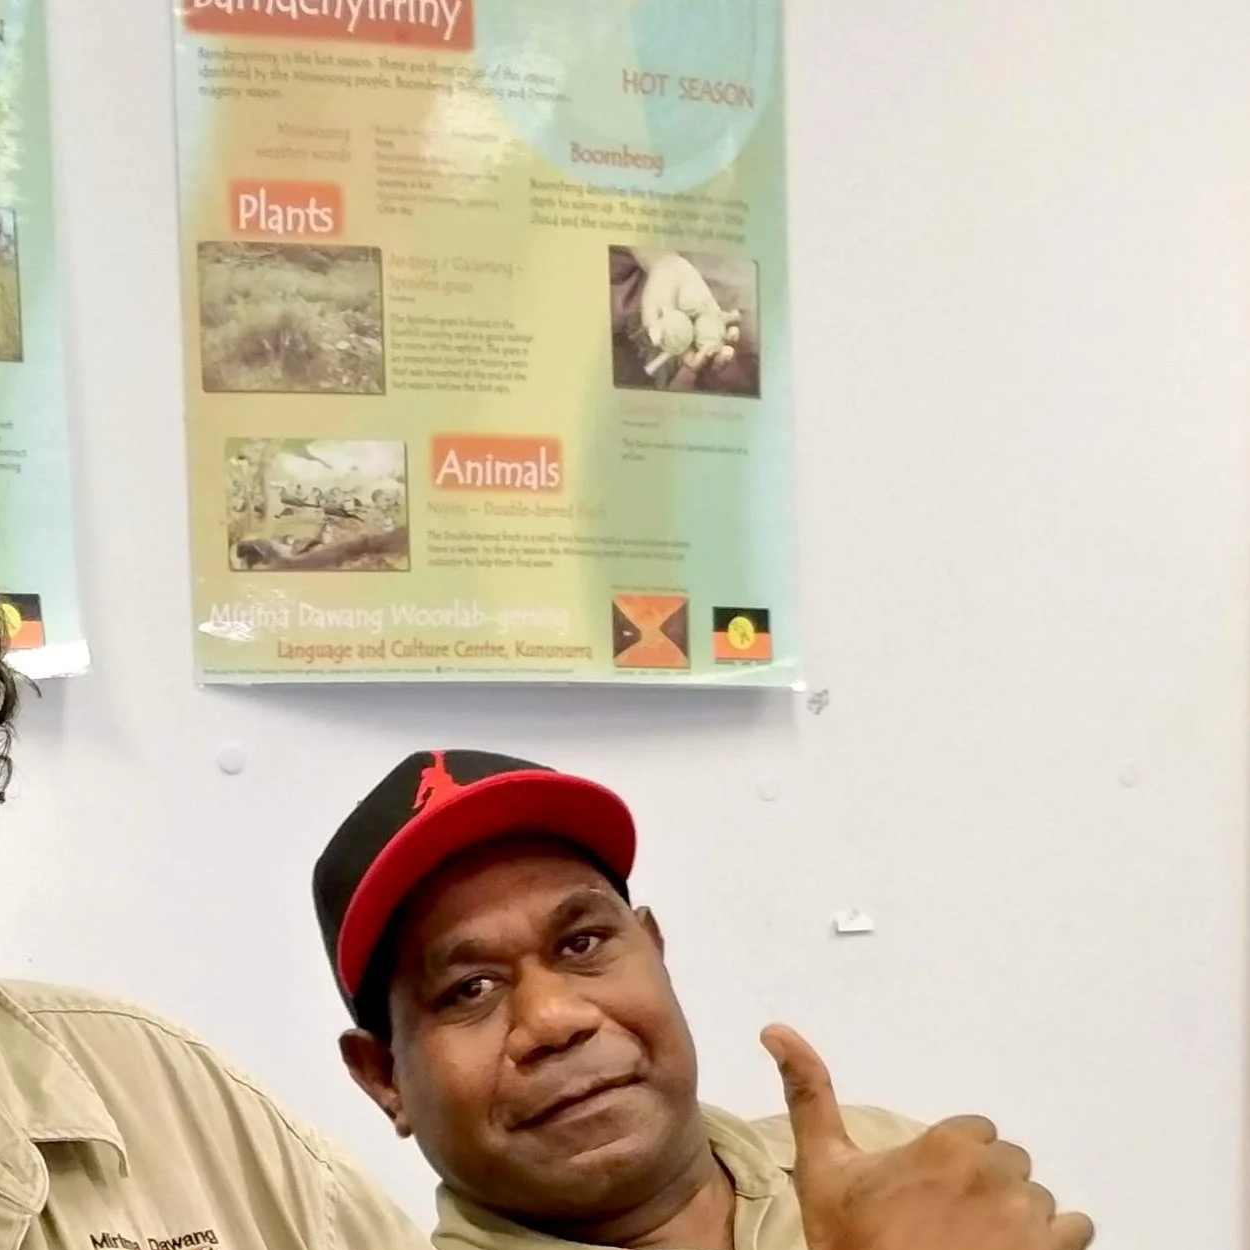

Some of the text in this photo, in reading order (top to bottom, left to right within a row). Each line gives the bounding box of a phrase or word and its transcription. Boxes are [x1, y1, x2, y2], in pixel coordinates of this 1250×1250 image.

[193, 0, 464, 42] enyirriny
[621, 68, 754, 110] HOT SEASON
[238, 186, 336, 236] Plants
[436, 443, 563, 491] Animals
[298, 602, 384, 638] Dawang
[277, 637, 592, 665] Language and Culture Centre, Kununurra
